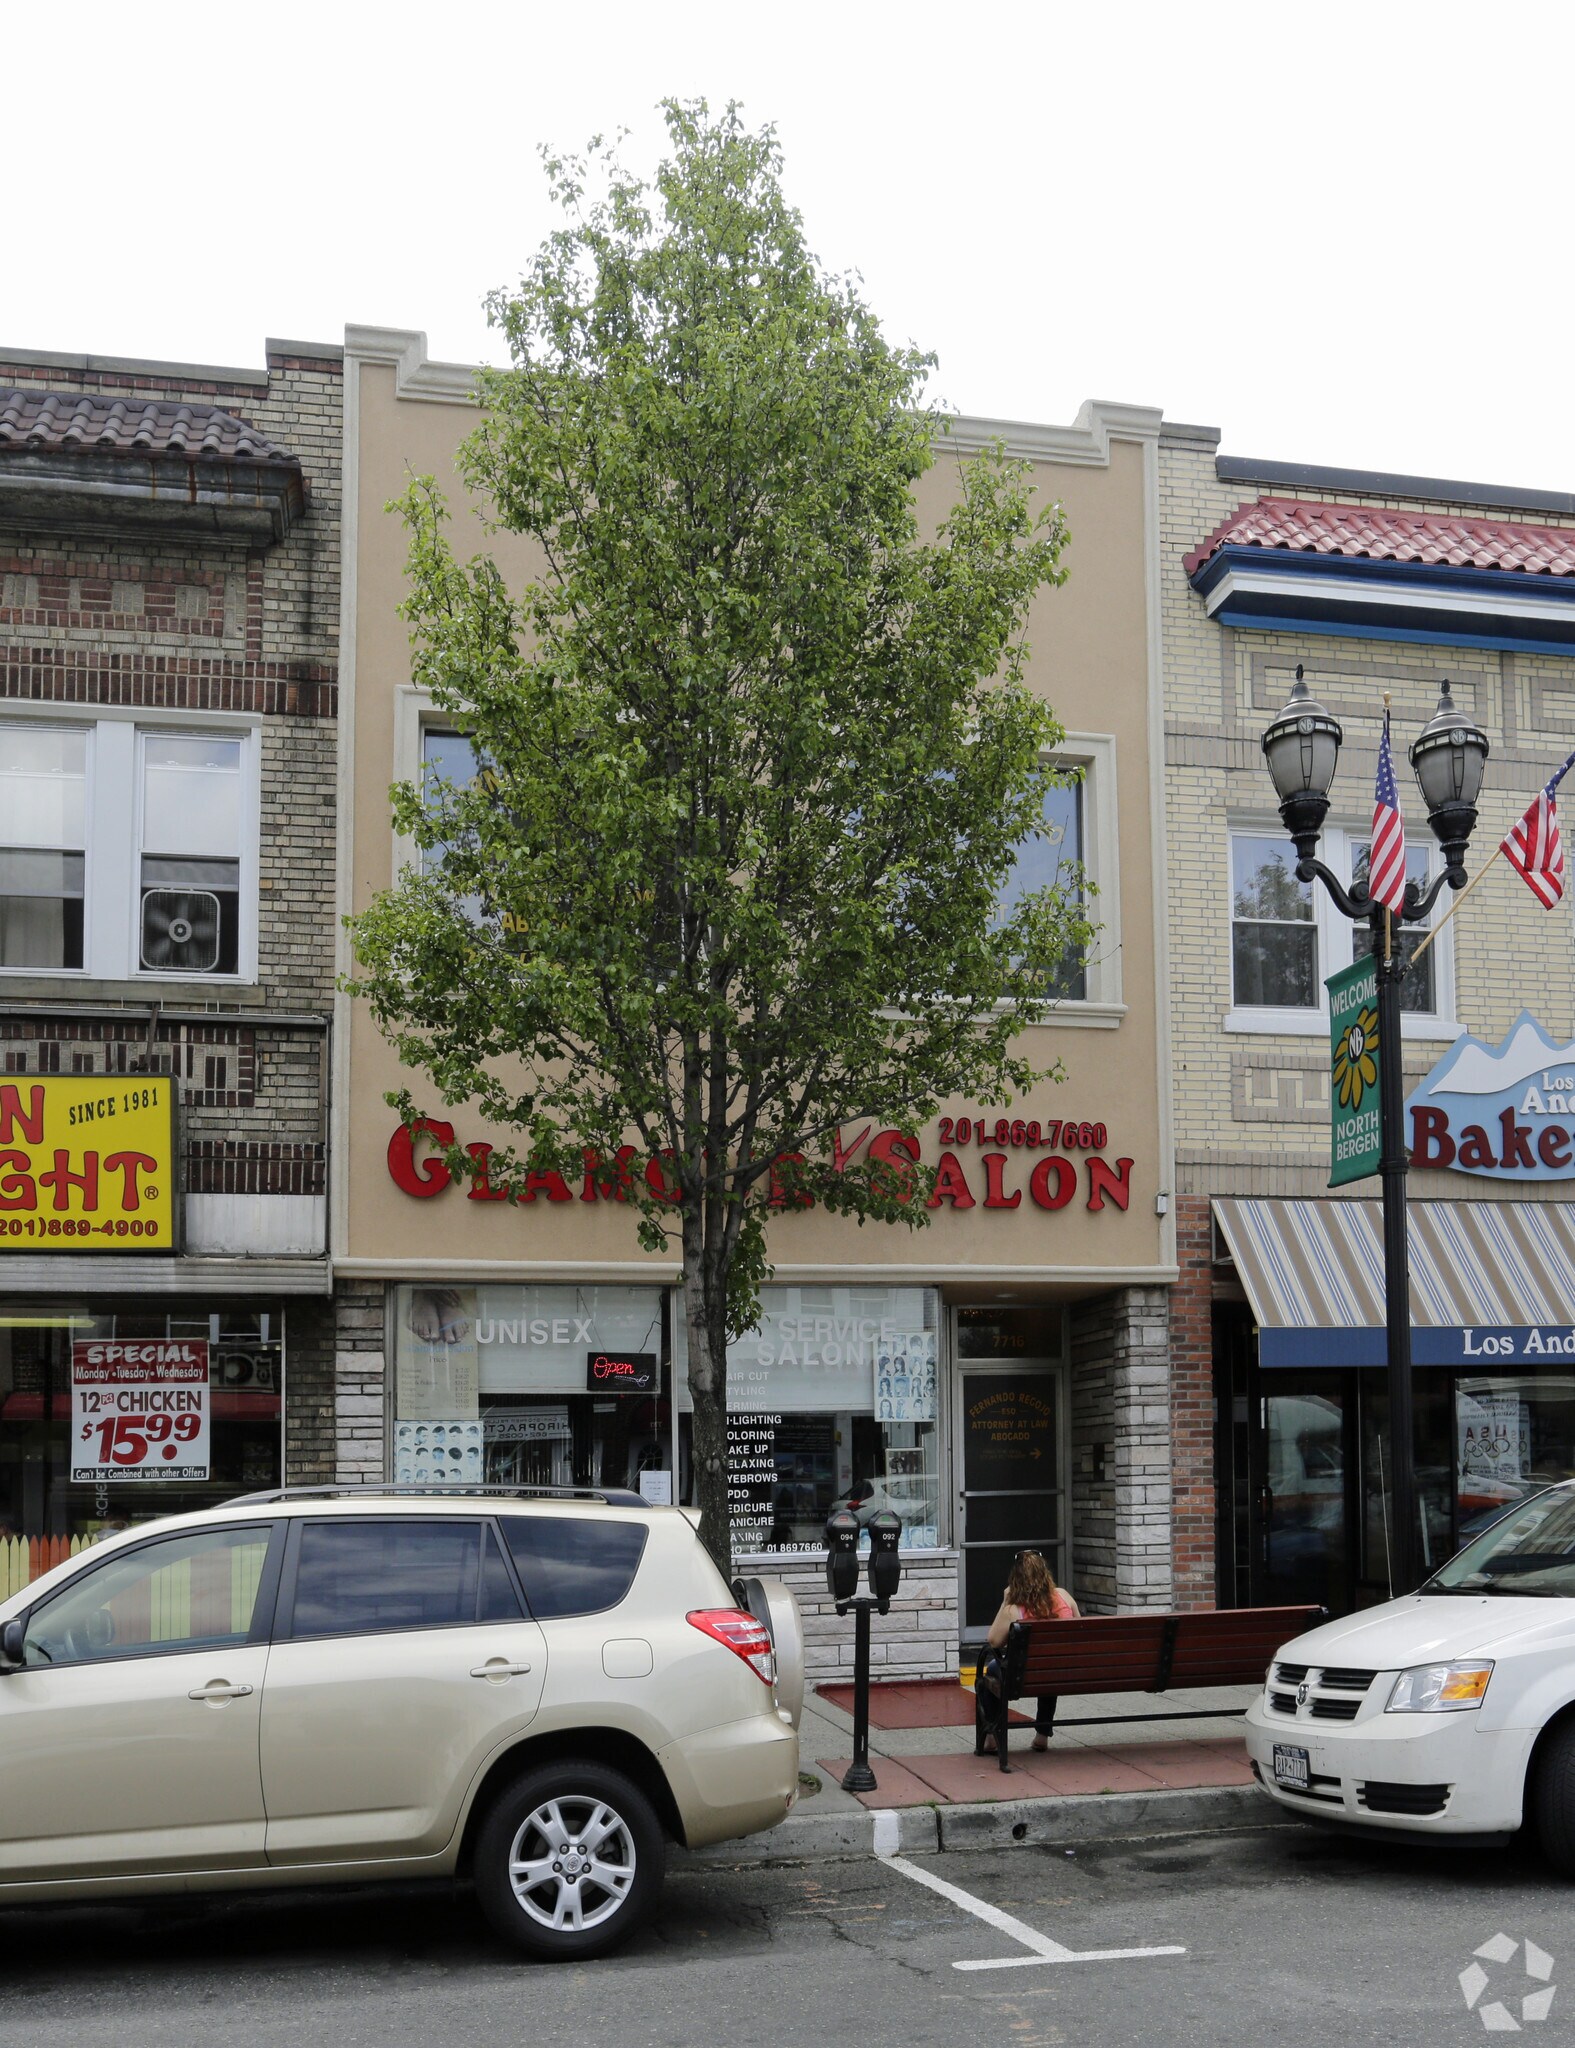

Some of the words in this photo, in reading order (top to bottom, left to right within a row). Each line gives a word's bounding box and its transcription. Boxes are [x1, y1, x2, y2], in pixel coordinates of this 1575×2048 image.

[1331, 974, 1378, 1017] WELCOME
[1542, 1072, 1574, 1091] Los
[69, 1097, 115, 1125] SINCE
[123, 1087, 158, 1113] 1981
[1336, 1109, 1379, 1141] NORTH
[1408, 1105, 1575, 1169] Bake
[1336, 1131, 1379, 1161] BERGEN
[475, 1318, 592, 1344] UNISEX
[778, 1319, 897, 1342] SERVICE
[1463, 1329, 1514, 1356] Los
[87, 1345, 196, 1363] SPECIAL
[757, 1342, 864, 1366] SALON
[75, 1366, 109, 1380] Monday
[116, 1365, 150, 1379] Tuesday
[156, 1363, 204, 1379] Wednesday
[593, 1356, 635, 1378] Open
[727, 1372, 744, 1381] AIR
[749, 1371, 769, 1381] CUT
[727, 1386, 766, 1396] TYLING
[80, 1392, 101, 1413] 12
[116, 1390, 202, 1412] CHICKEN
[727, 1401, 767, 1411] ERMING
[971, 1420, 1014, 1430] ATTORNEY
[1017, 1420, 1028, 1429] AT
[1031, 1419, 1049, 1429] LAW
[726, 1430, 775, 1441] OLORING
[991, 1432, 1031, 1442] ABOGADO
[728, 1445, 750, 1455] AKE
[754, 1444, 769, 1454] UP
[729, 1459, 775, 1469] ELAXING
[76, 1469, 94, 1479] Can't
[96, 1469, 106, 1478] be
[107, 1468, 143, 1479] Combined
[144, 1467, 160, 1477] with
[161, 1467, 181, 1477] other
[182, 1466, 205, 1477] Offers
[727, 1472, 778, 1484] YEBROWS
[727, 1489, 749, 1499] PDO
[728, 1502, 773, 1514] EDICURE
[729, 1516, 775, 1528] ANICURE
[780, 1542, 798, 1552] 869
[798, 1542, 823, 1552] 7660
